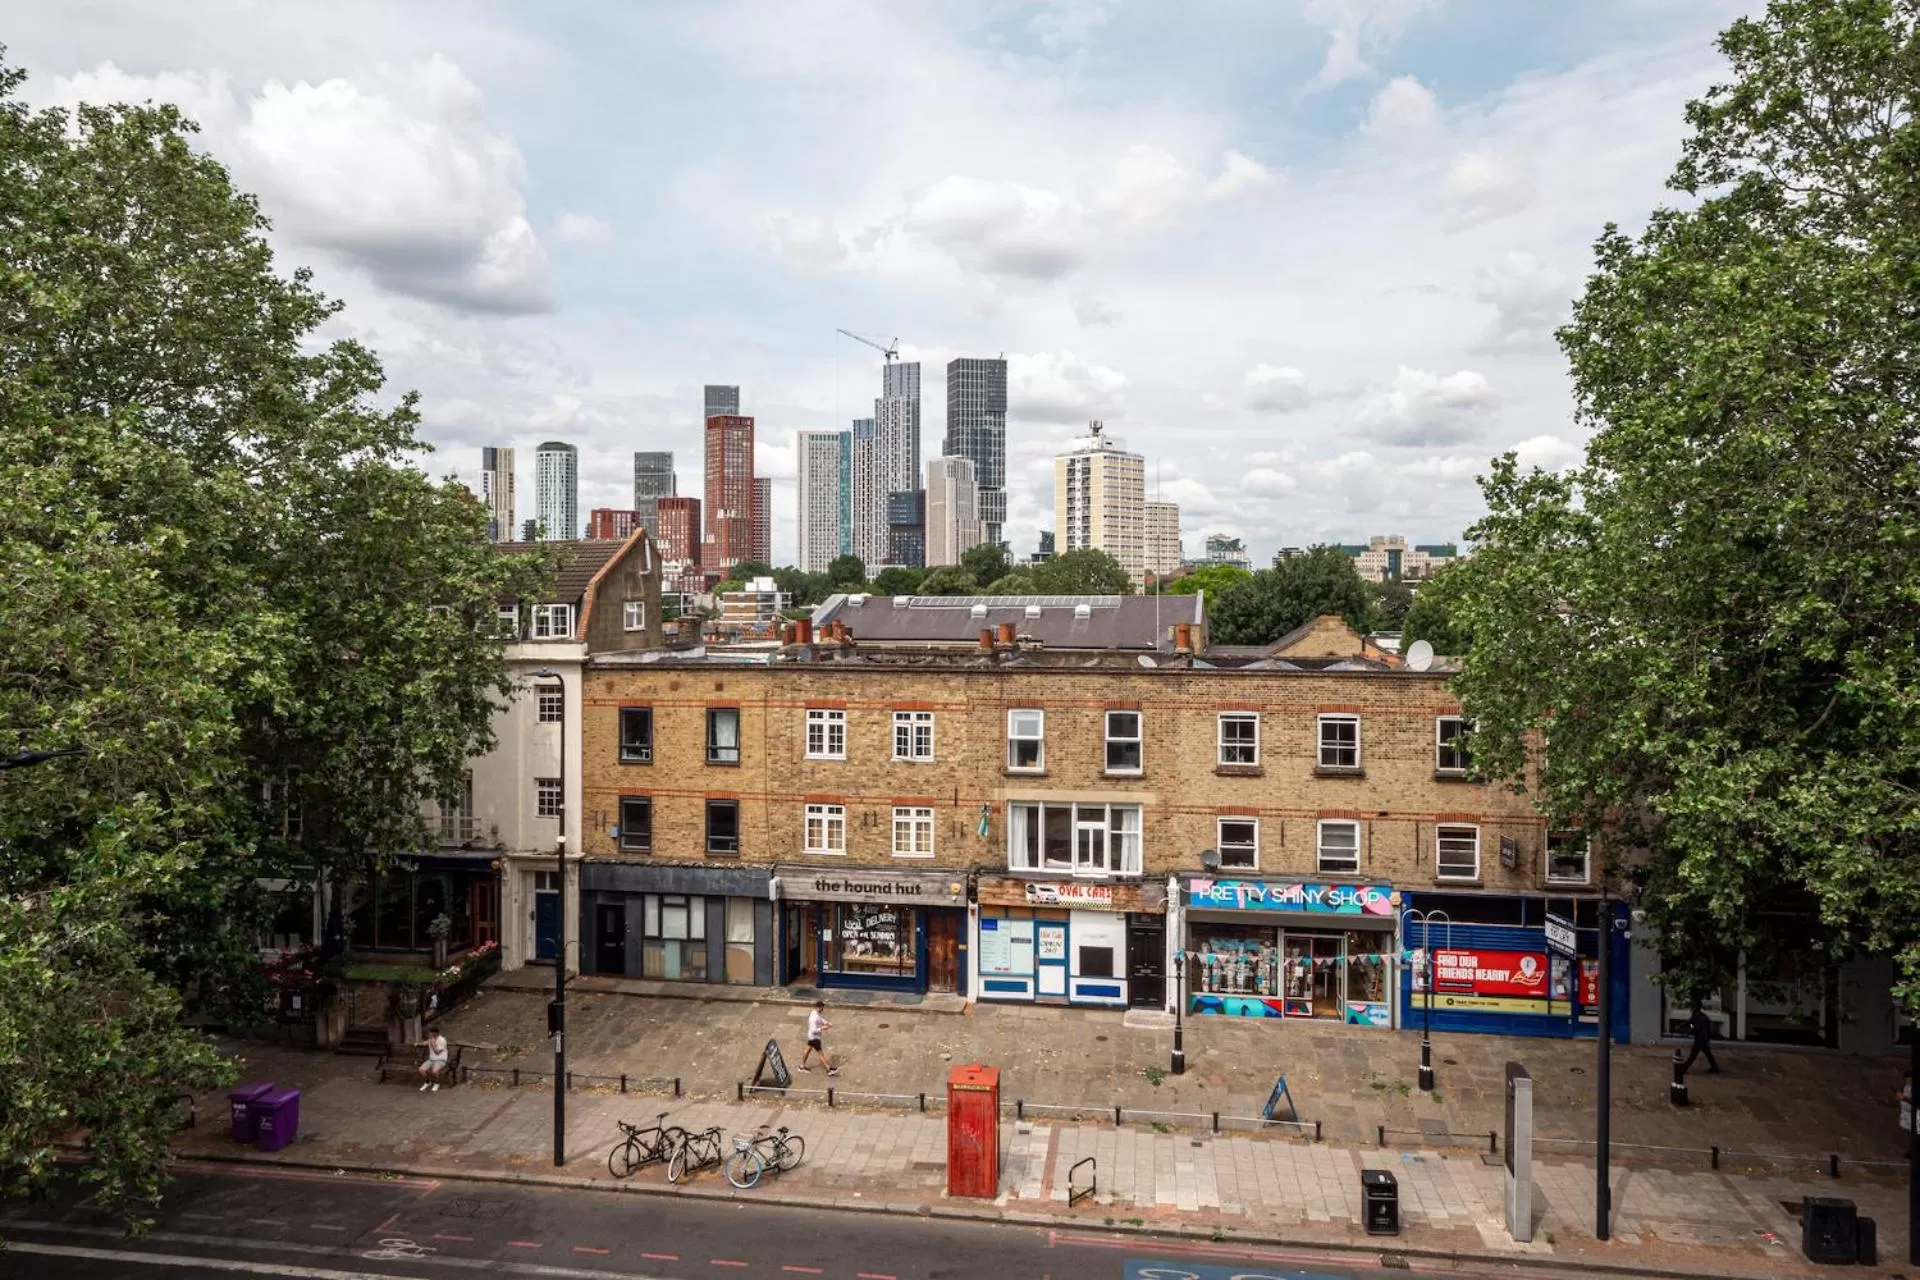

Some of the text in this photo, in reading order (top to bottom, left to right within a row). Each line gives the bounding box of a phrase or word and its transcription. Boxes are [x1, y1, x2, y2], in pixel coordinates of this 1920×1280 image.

[815, 880, 921, 895] the hound hut
[1059, 884, 1083, 897] OVAL
[1200, 885, 1380, 906] PRETTY SHINY SHOP
[1437, 954, 1458, 967] FIND
[1459, 955, 1478, 968] OUR
[1437, 967, 1511, 982] FRIENDS NEARBY
